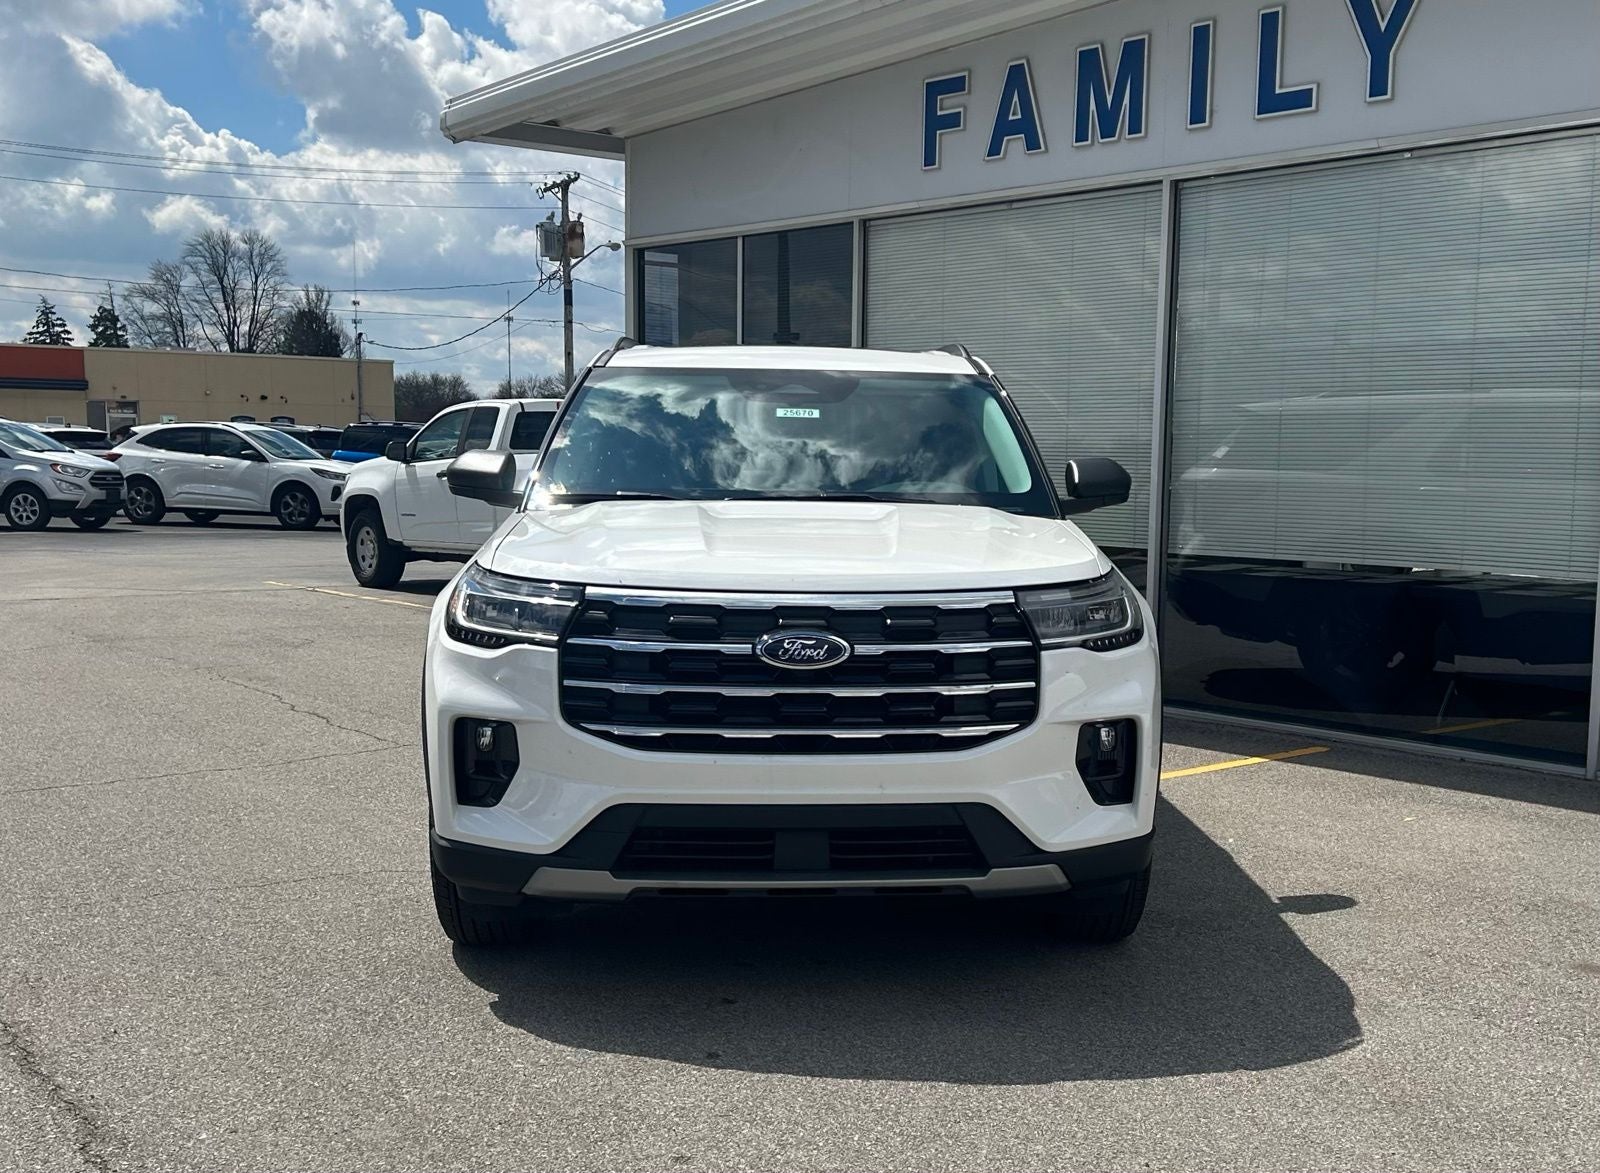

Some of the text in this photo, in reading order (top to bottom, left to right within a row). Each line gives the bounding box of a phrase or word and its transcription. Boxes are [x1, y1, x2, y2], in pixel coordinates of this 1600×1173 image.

[922, 0, 1419, 170] FAMILY
[783, 409, 814, 417] 25670
[779, 639, 828, 660] Ford
